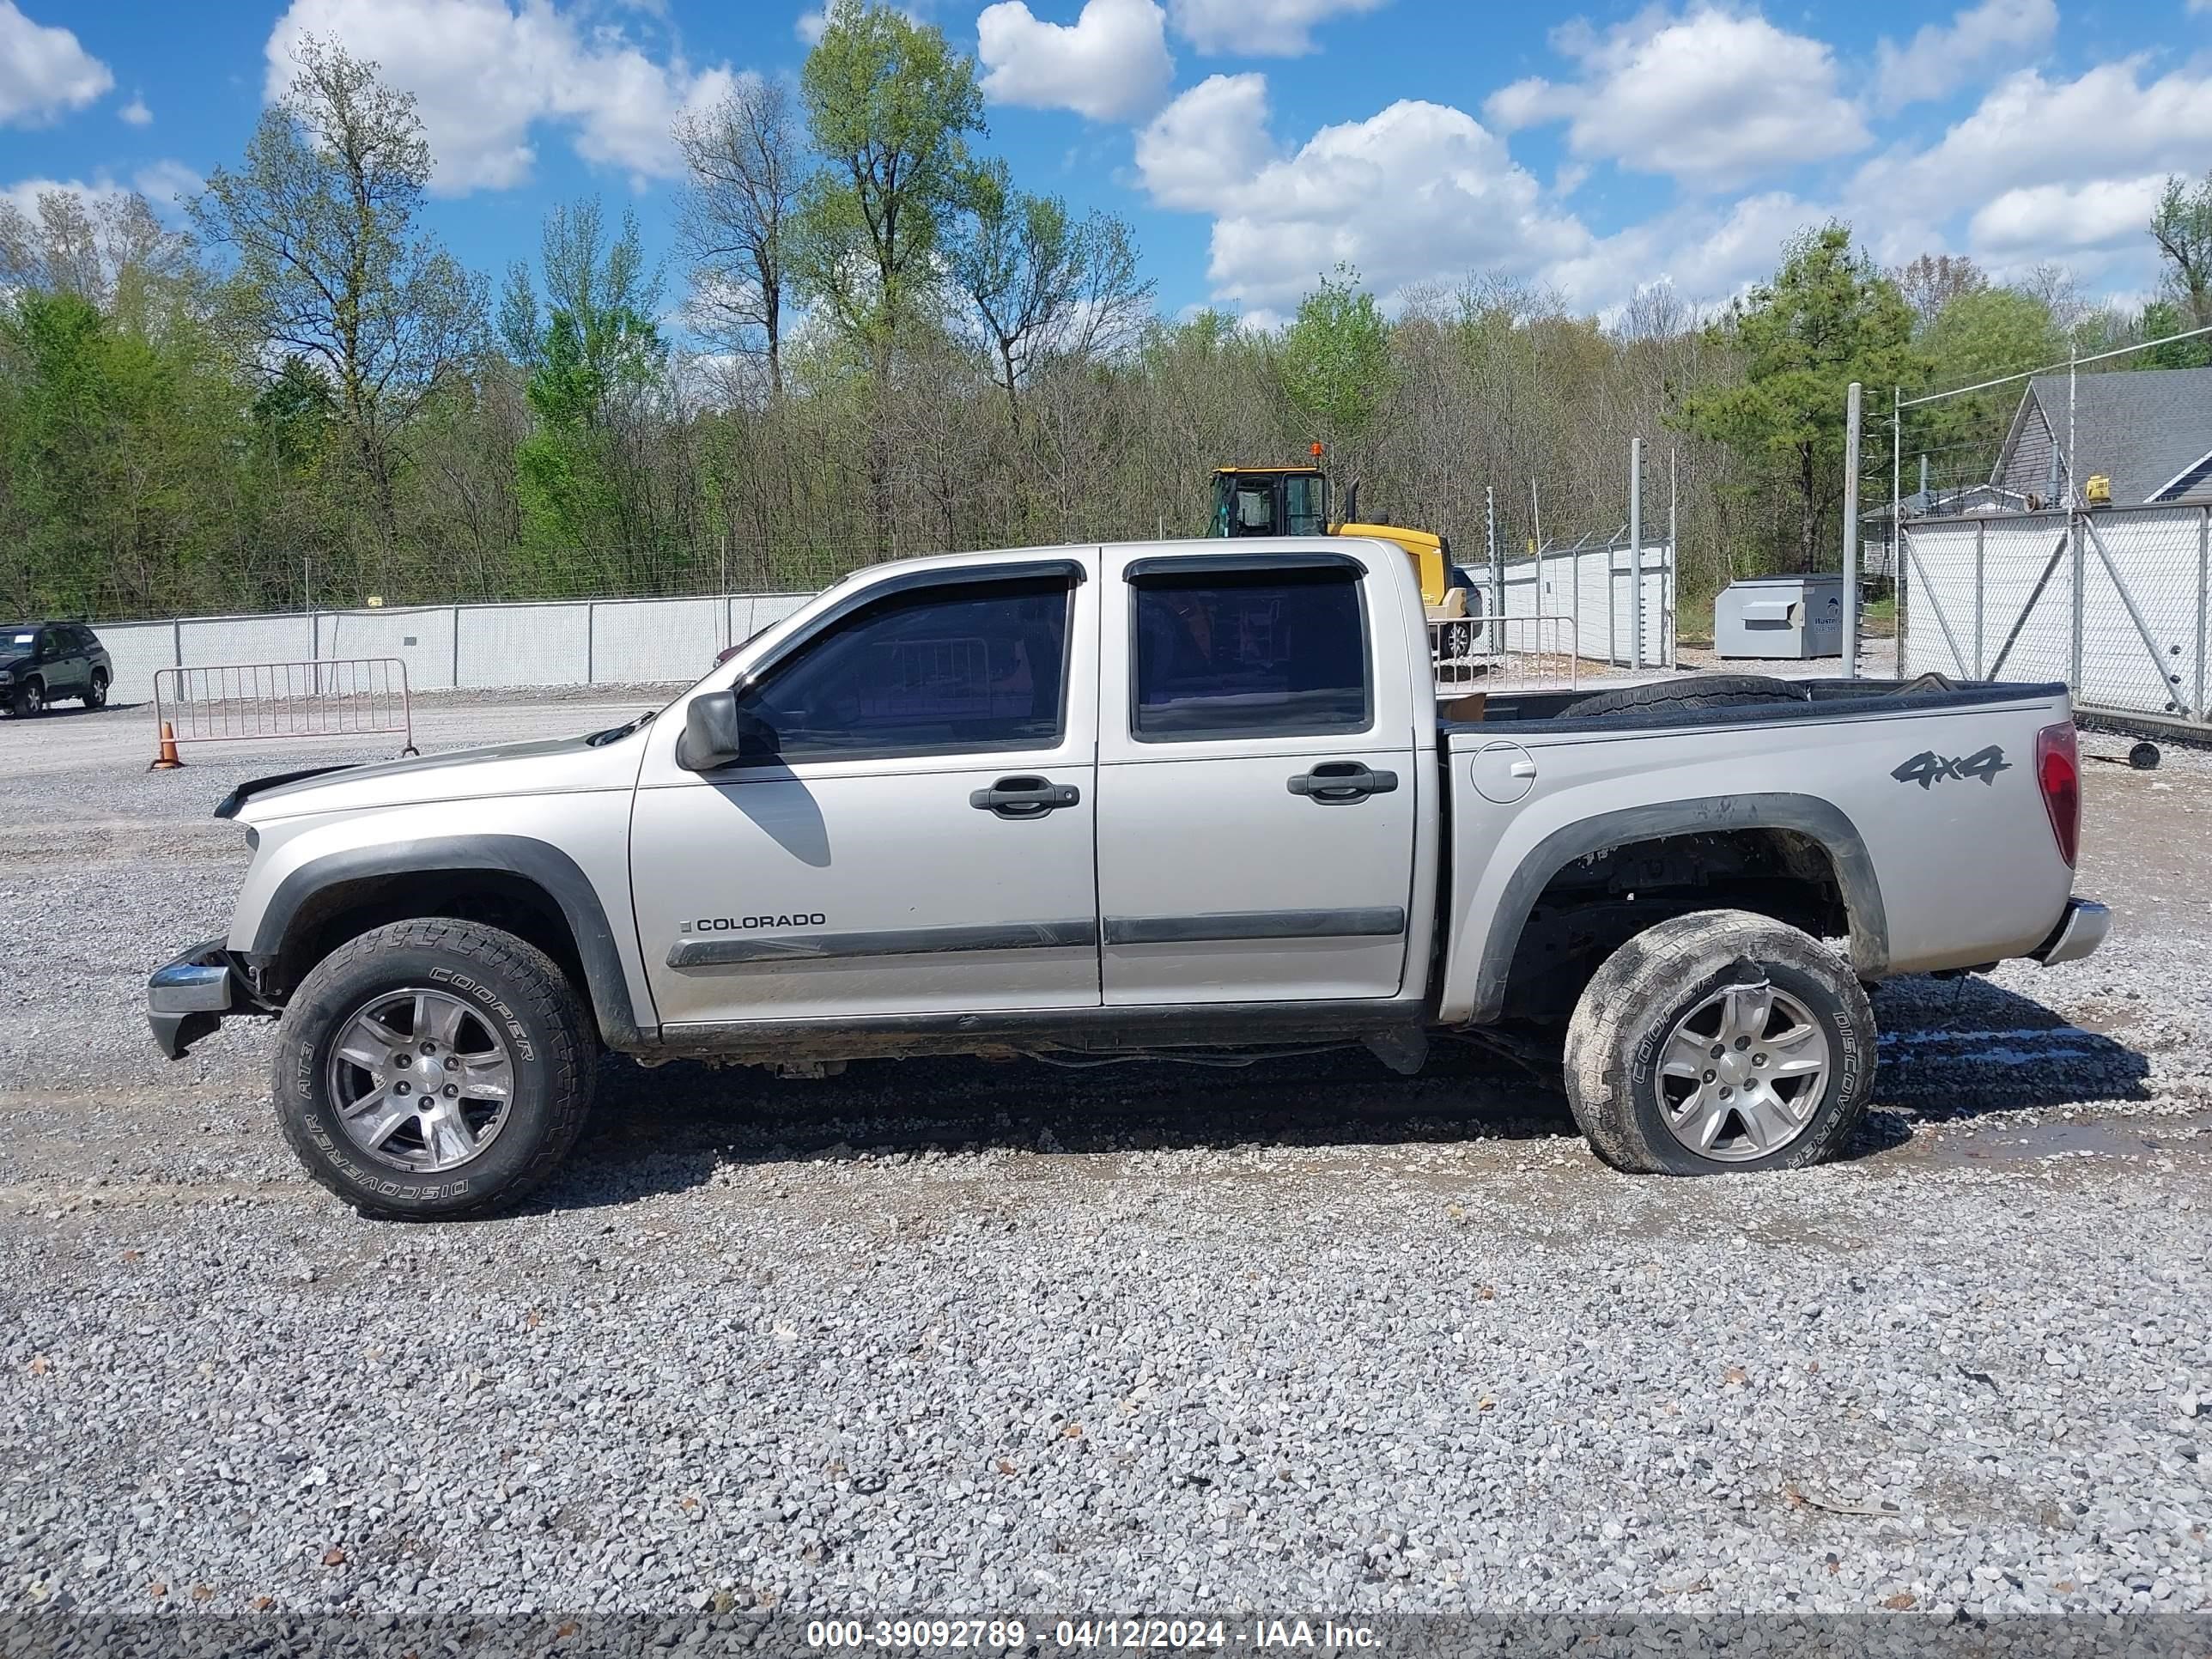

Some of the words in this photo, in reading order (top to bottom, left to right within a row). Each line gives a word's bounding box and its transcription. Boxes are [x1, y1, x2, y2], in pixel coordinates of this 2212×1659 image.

[696, 913, 826, 931] COLORADO
[429, 967, 535, 1062] COOPER
[1633, 973, 1717, 1085] COOPER
[306, 1114, 469, 1200] DISCOVERER
